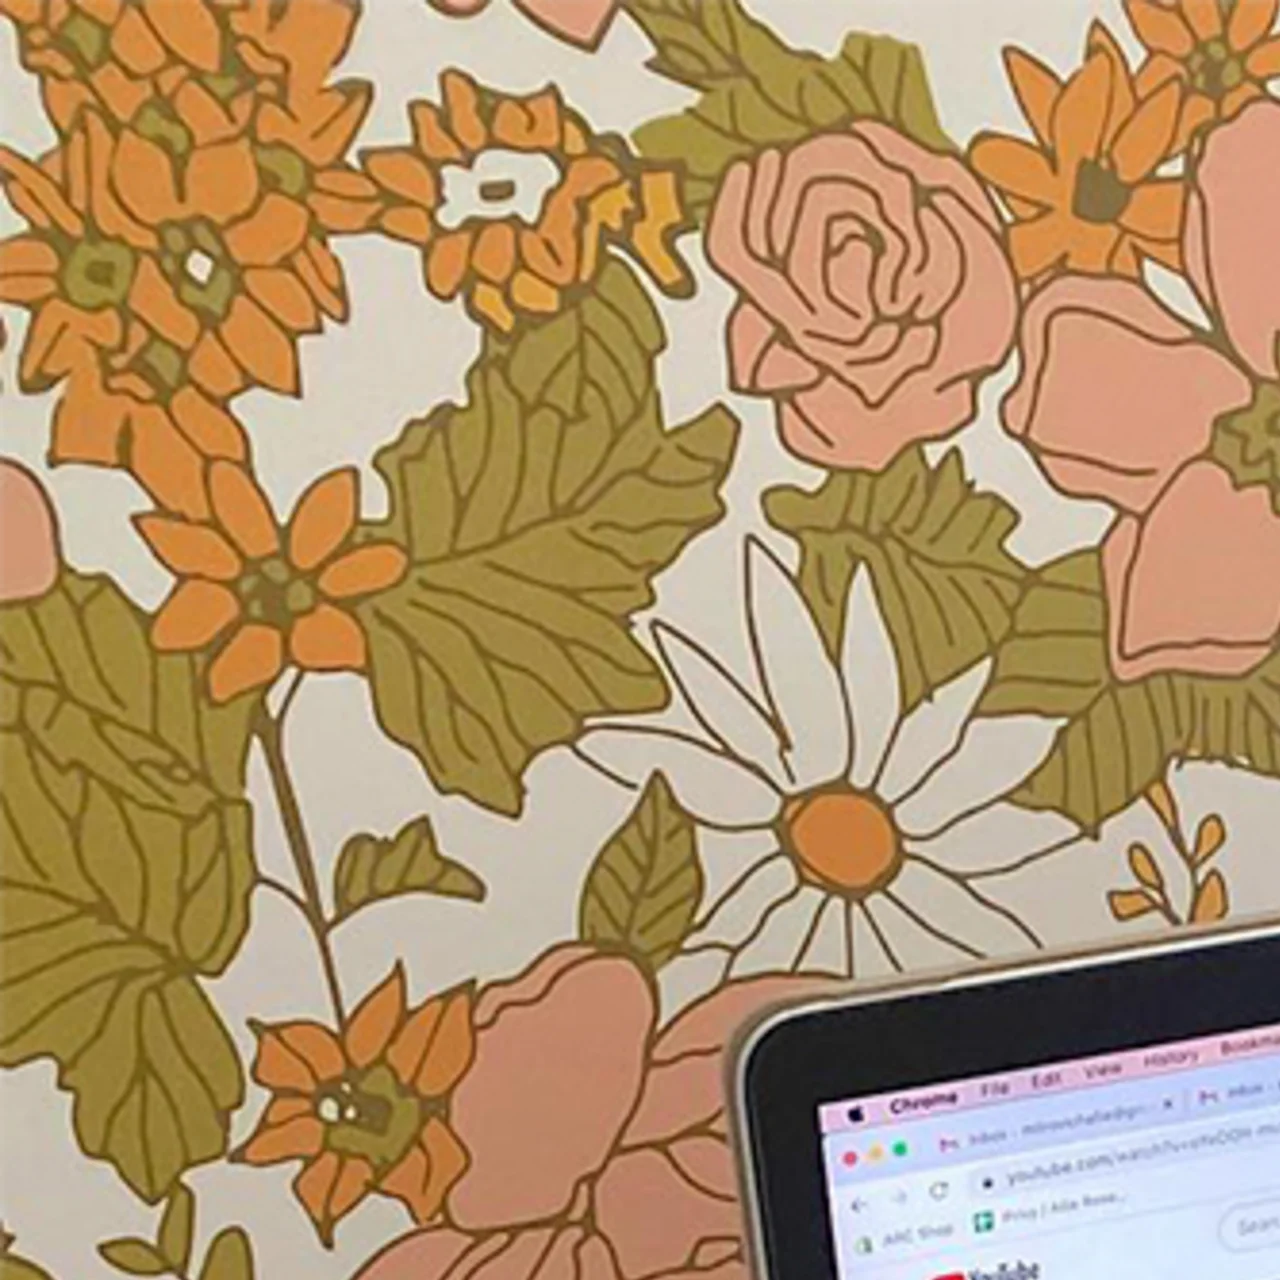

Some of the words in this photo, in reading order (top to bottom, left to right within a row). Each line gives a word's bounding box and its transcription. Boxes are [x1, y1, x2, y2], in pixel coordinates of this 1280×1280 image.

[889, 1091, 959, 1116] Chrome
[980, 1082, 1011, 1097] File
[1030, 1071, 1062, 1090] Edit
[1084, 1063, 1123, 1080] View
[1143, 1049, 1199, 1068] History
